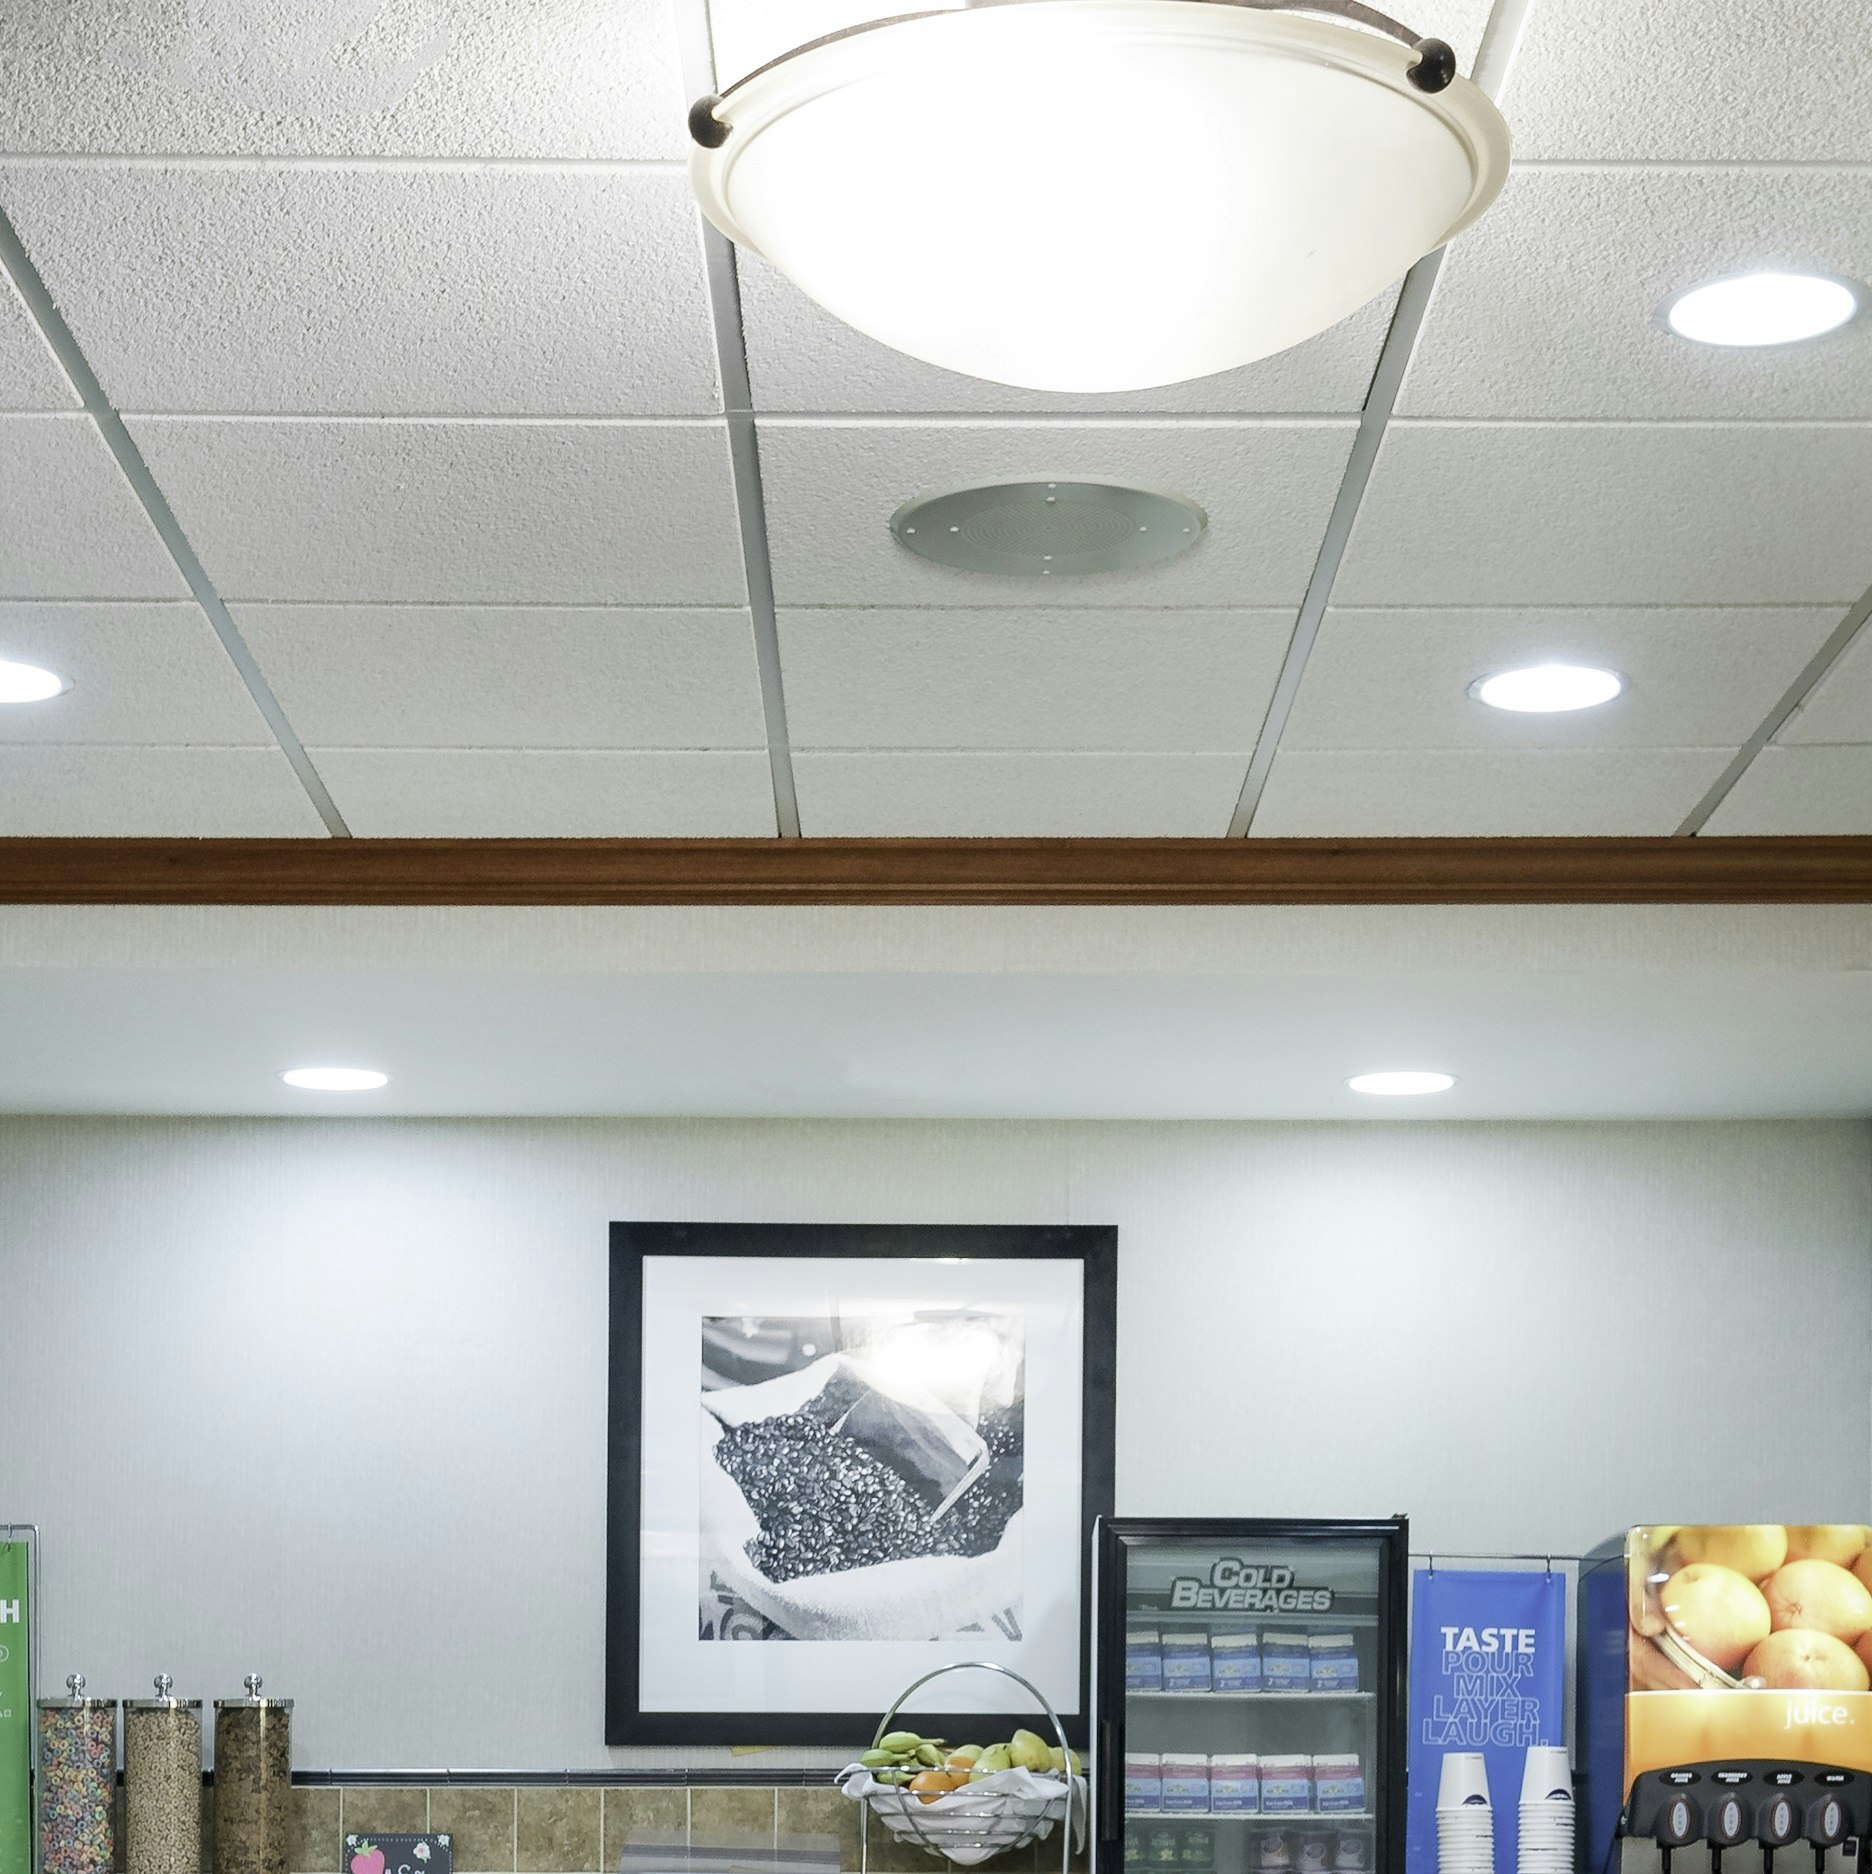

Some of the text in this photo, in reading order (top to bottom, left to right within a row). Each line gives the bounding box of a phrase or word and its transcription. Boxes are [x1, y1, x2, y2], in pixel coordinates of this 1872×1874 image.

[1212, 1559, 1293, 1589] COLD
[1171, 1579, 1333, 1611] BEVERAGES
[1440, 1626, 1536, 1653] TASTE
[1442, 1650, 1534, 1677] POUR
[1453, 1672, 1521, 1699] MIX
[1433, 1695, 1540, 1723] LAYER
[1783, 1698, 1856, 1731] juice.
[1422, 1718, 1550, 1747] LAUGH.
